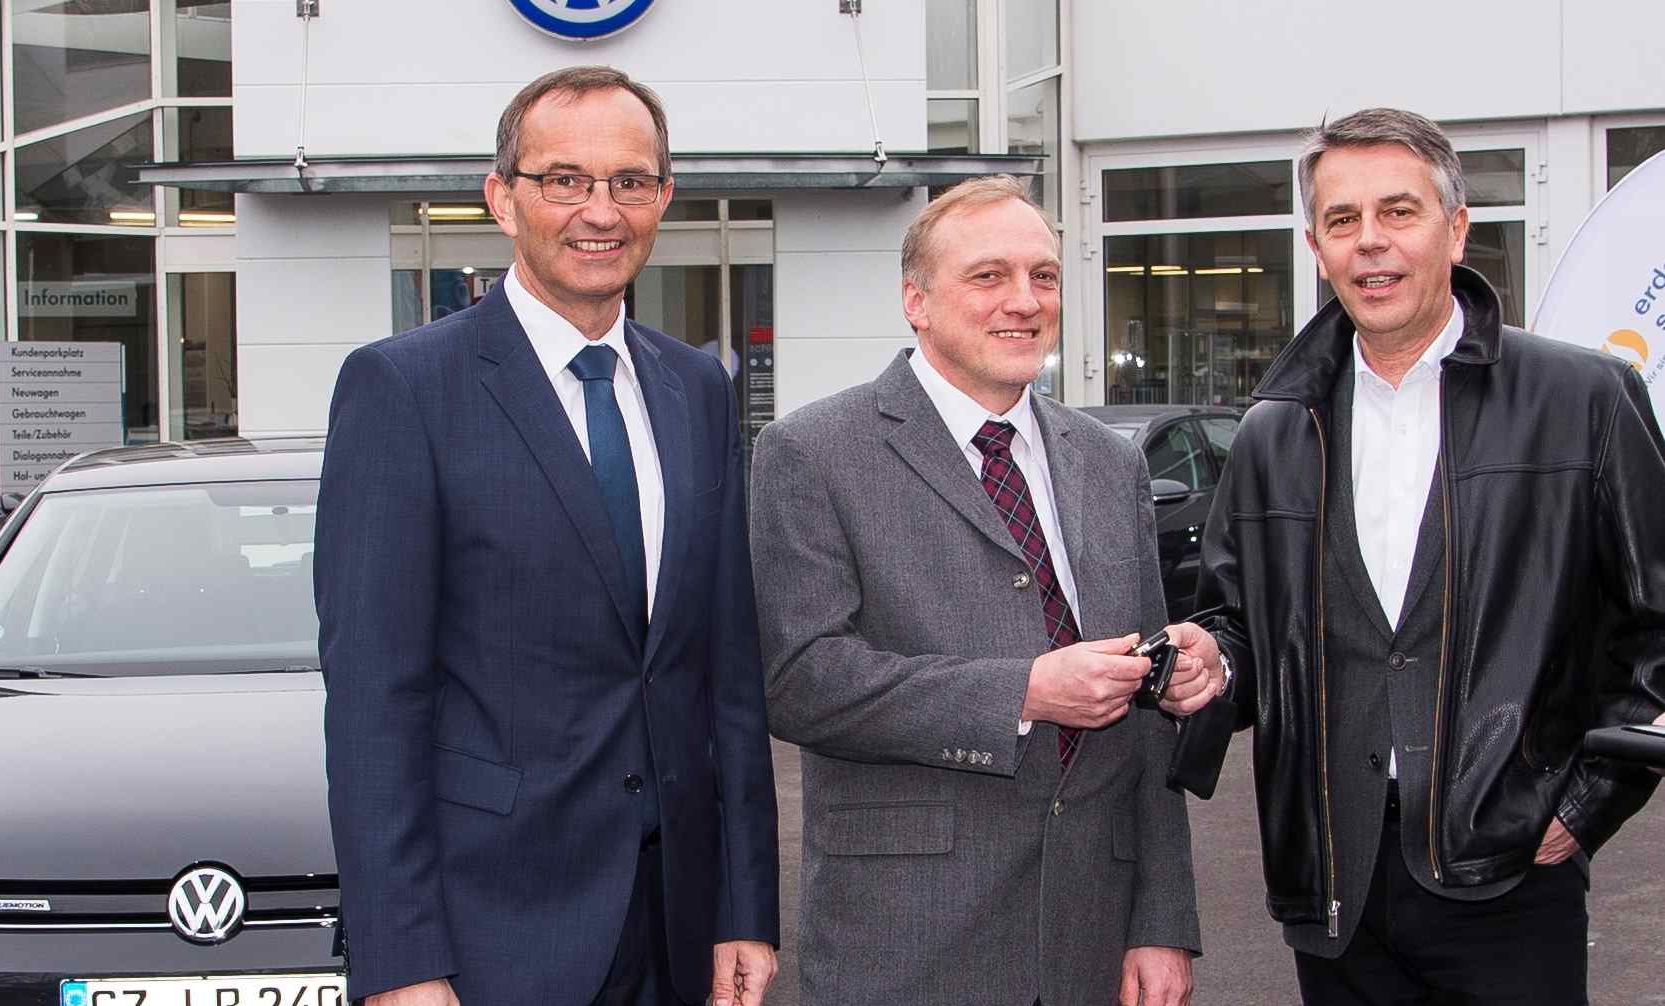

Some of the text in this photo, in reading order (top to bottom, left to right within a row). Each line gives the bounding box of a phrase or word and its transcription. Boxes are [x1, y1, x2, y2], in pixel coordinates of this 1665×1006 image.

[1634, 264, 1665, 315] erd
[25, 289, 128, 305] Information
[11, 348, 84, 359] Kundenparkplatz
[11, 367, 82, 377] Serviceannahme
[12, 388, 59, 399] Neuwagen
[12, 408, 86, 420] Gebrauchtwagen
[12, 429, 72, 440] Teile/Zubehör
[13, 470, 50, 480] Hol- un
